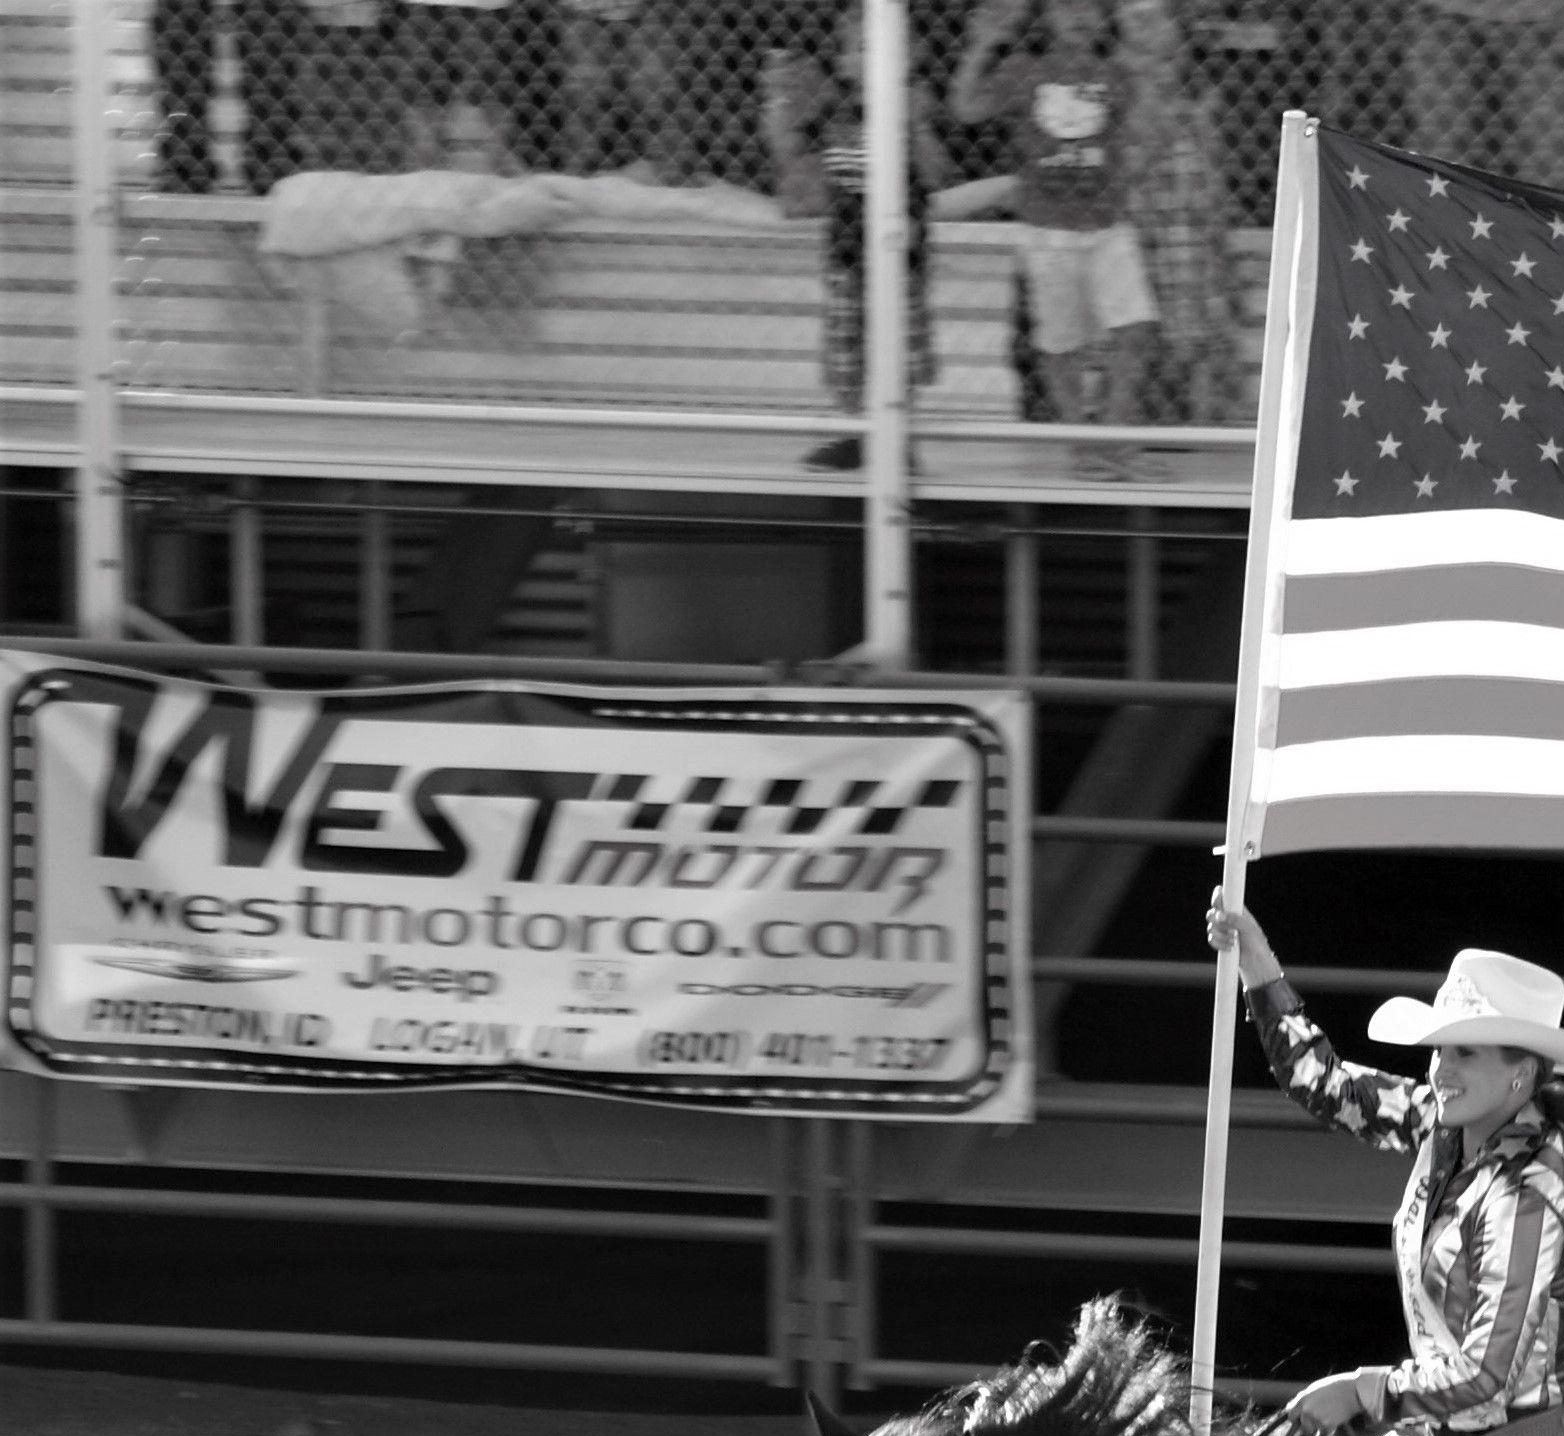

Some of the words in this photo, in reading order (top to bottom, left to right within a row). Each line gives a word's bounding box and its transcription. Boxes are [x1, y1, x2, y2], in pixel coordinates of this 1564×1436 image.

[564, 840, 948, 916] MOTOR
[105, 886, 953, 964] westmotorco.com
[341, 953, 499, 1002] Jeep
